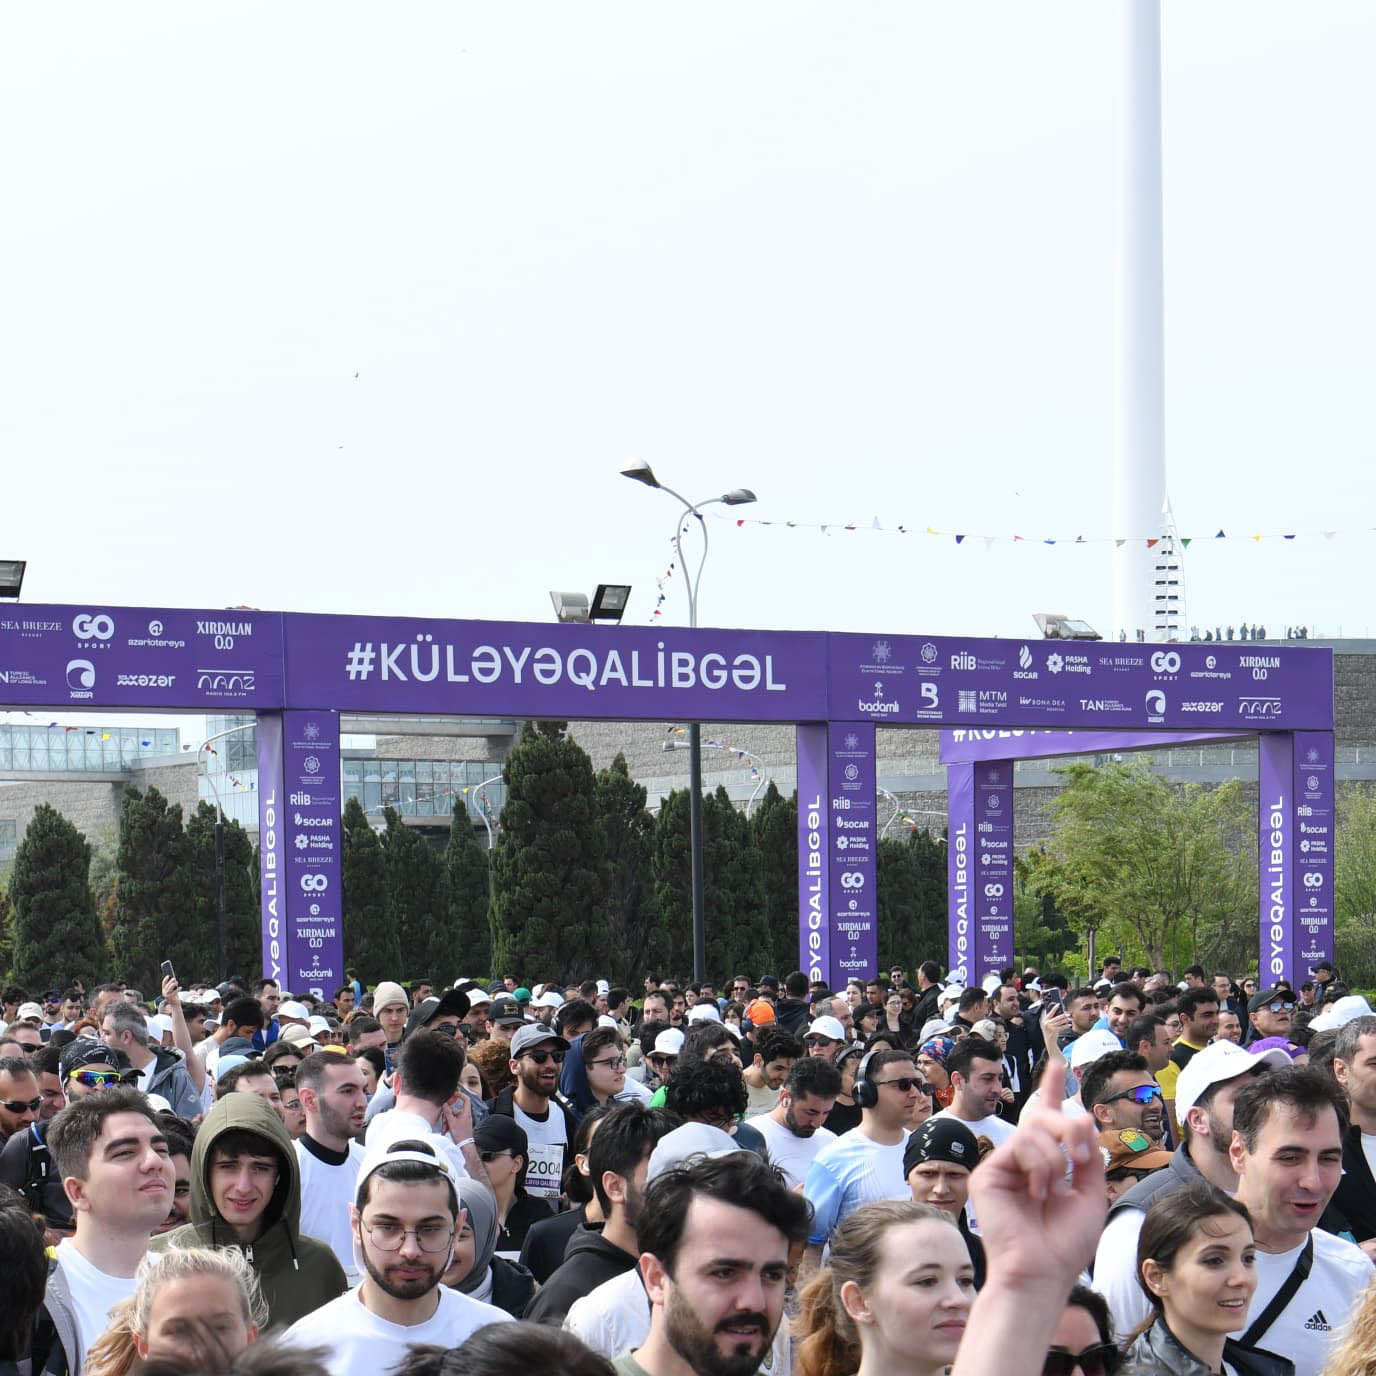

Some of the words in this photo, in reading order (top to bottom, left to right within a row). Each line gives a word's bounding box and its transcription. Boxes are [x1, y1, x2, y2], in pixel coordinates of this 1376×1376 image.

[0, 620, 20, 630] SEA
[23, 621, 62, 631] BREEZE
[73, 614, 115, 640] GO
[196, 620, 252, 636] XIRDALAN
[345, 634, 786, 692] #KÜLƏYƏQALİBGƏL
[1065, 656, 1088, 664] PASHA
[1150, 651, 1181, 673] GO
[1239, 656, 1280, 668] XIRDALAN
[1013, 671, 1038, 680] SOCAR
[1065, 665, 1092, 675] Holding
[979, 691, 1007, 701] MTM
[1080, 700, 1105, 711] TAN
[303, 818, 333, 826] SOCAR
[300, 874, 328, 891] GO
[840, 872, 865, 888] GO
[1303, 872, 1323, 887] GO
[984, 884, 1004, 897] GO
